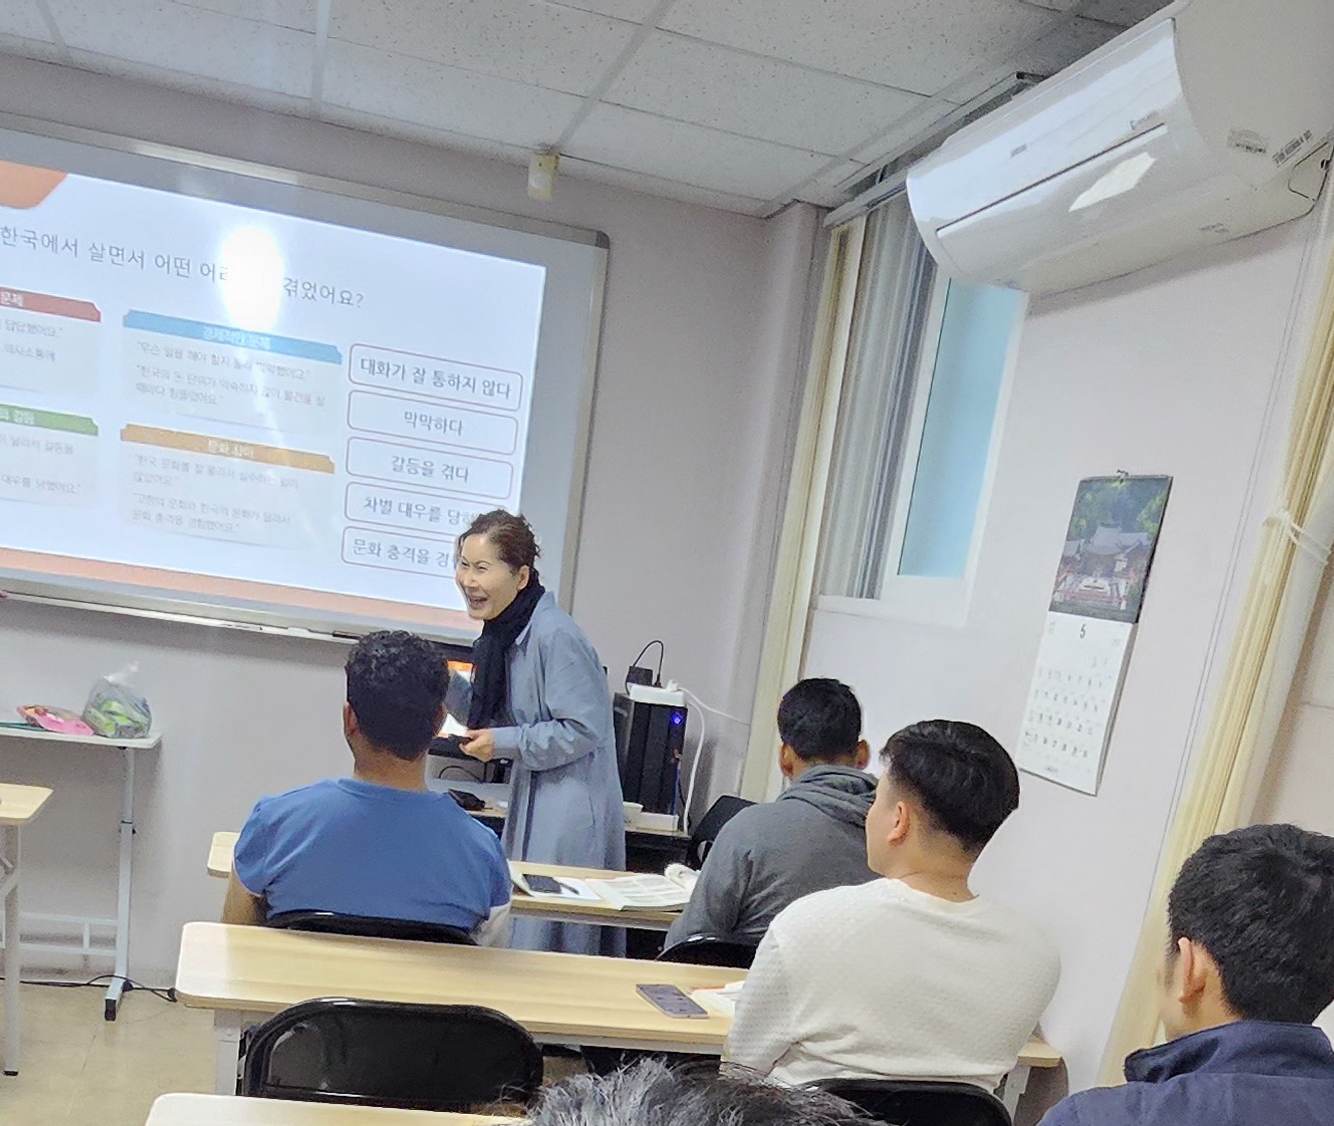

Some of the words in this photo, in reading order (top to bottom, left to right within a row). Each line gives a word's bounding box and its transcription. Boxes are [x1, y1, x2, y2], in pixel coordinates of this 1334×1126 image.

[0, 224, 77, 258] 한국에서
[88, 240, 144, 270] 살면서
[154, 252, 190, 278] 어떤
[283, 276, 364, 309] 겪었어요?
[359, 357, 406, 381] 대화가
[412, 366, 425, 385] 잘
[432, 369, 476, 393] 통하지
[481, 378, 511, 399] 않다
[403, 410, 463, 436] 막막하다
[390, 455, 435, 478] 갈등을
[440, 463, 469, 483] 겪다
[363, 495, 392, 515] 차별
[397, 500, 442, 523] 대우를
[352, 539, 381, 558] 문화
[386, 543, 430, 565] 충격을
[1080, 623, 1087, 640] 5
